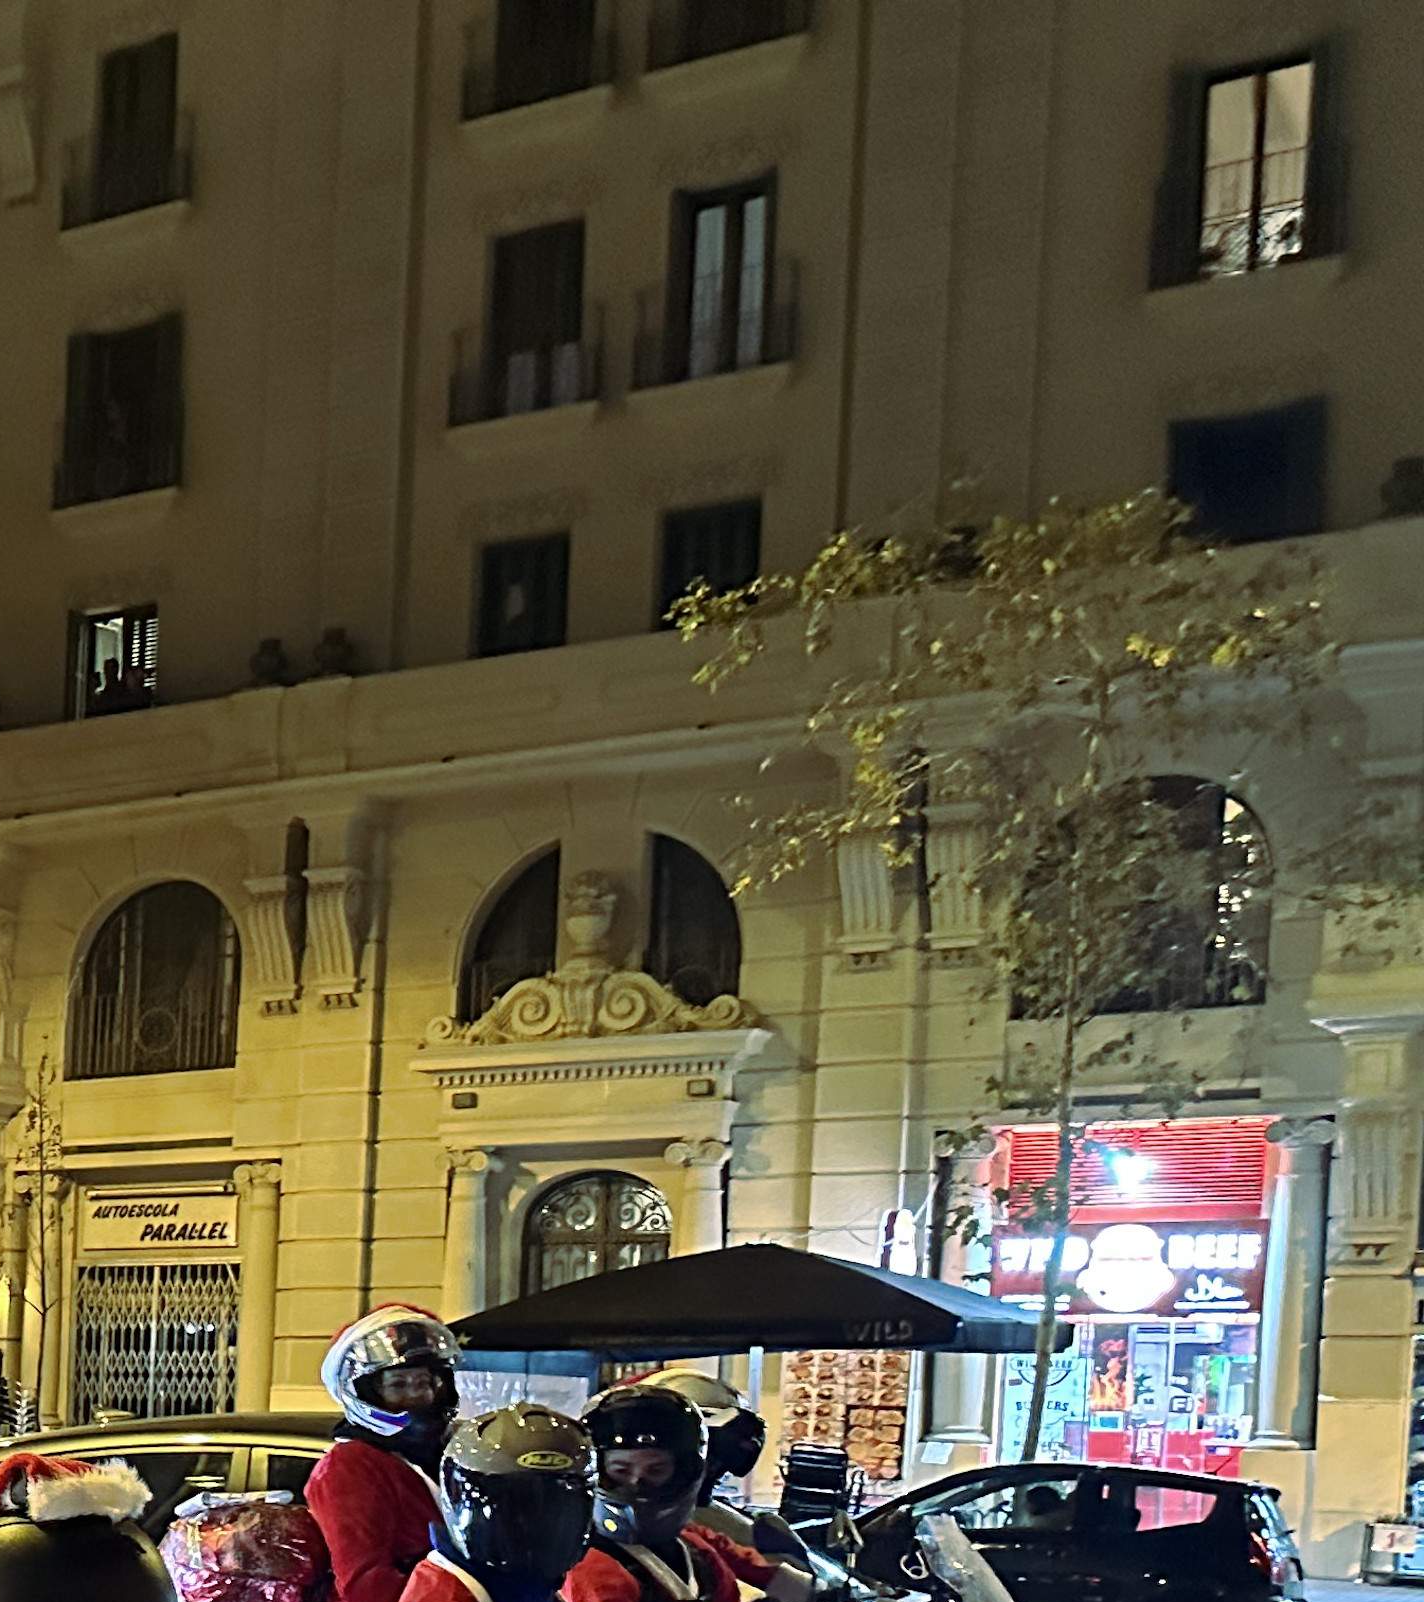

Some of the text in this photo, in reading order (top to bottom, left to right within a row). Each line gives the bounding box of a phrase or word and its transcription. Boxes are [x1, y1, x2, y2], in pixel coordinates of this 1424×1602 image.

[92, 1203, 180, 1219] AUTOESCOLA
[1168, 1233, 1261, 1270] BEEF
[848, 1320, 914, 1342] WILD
